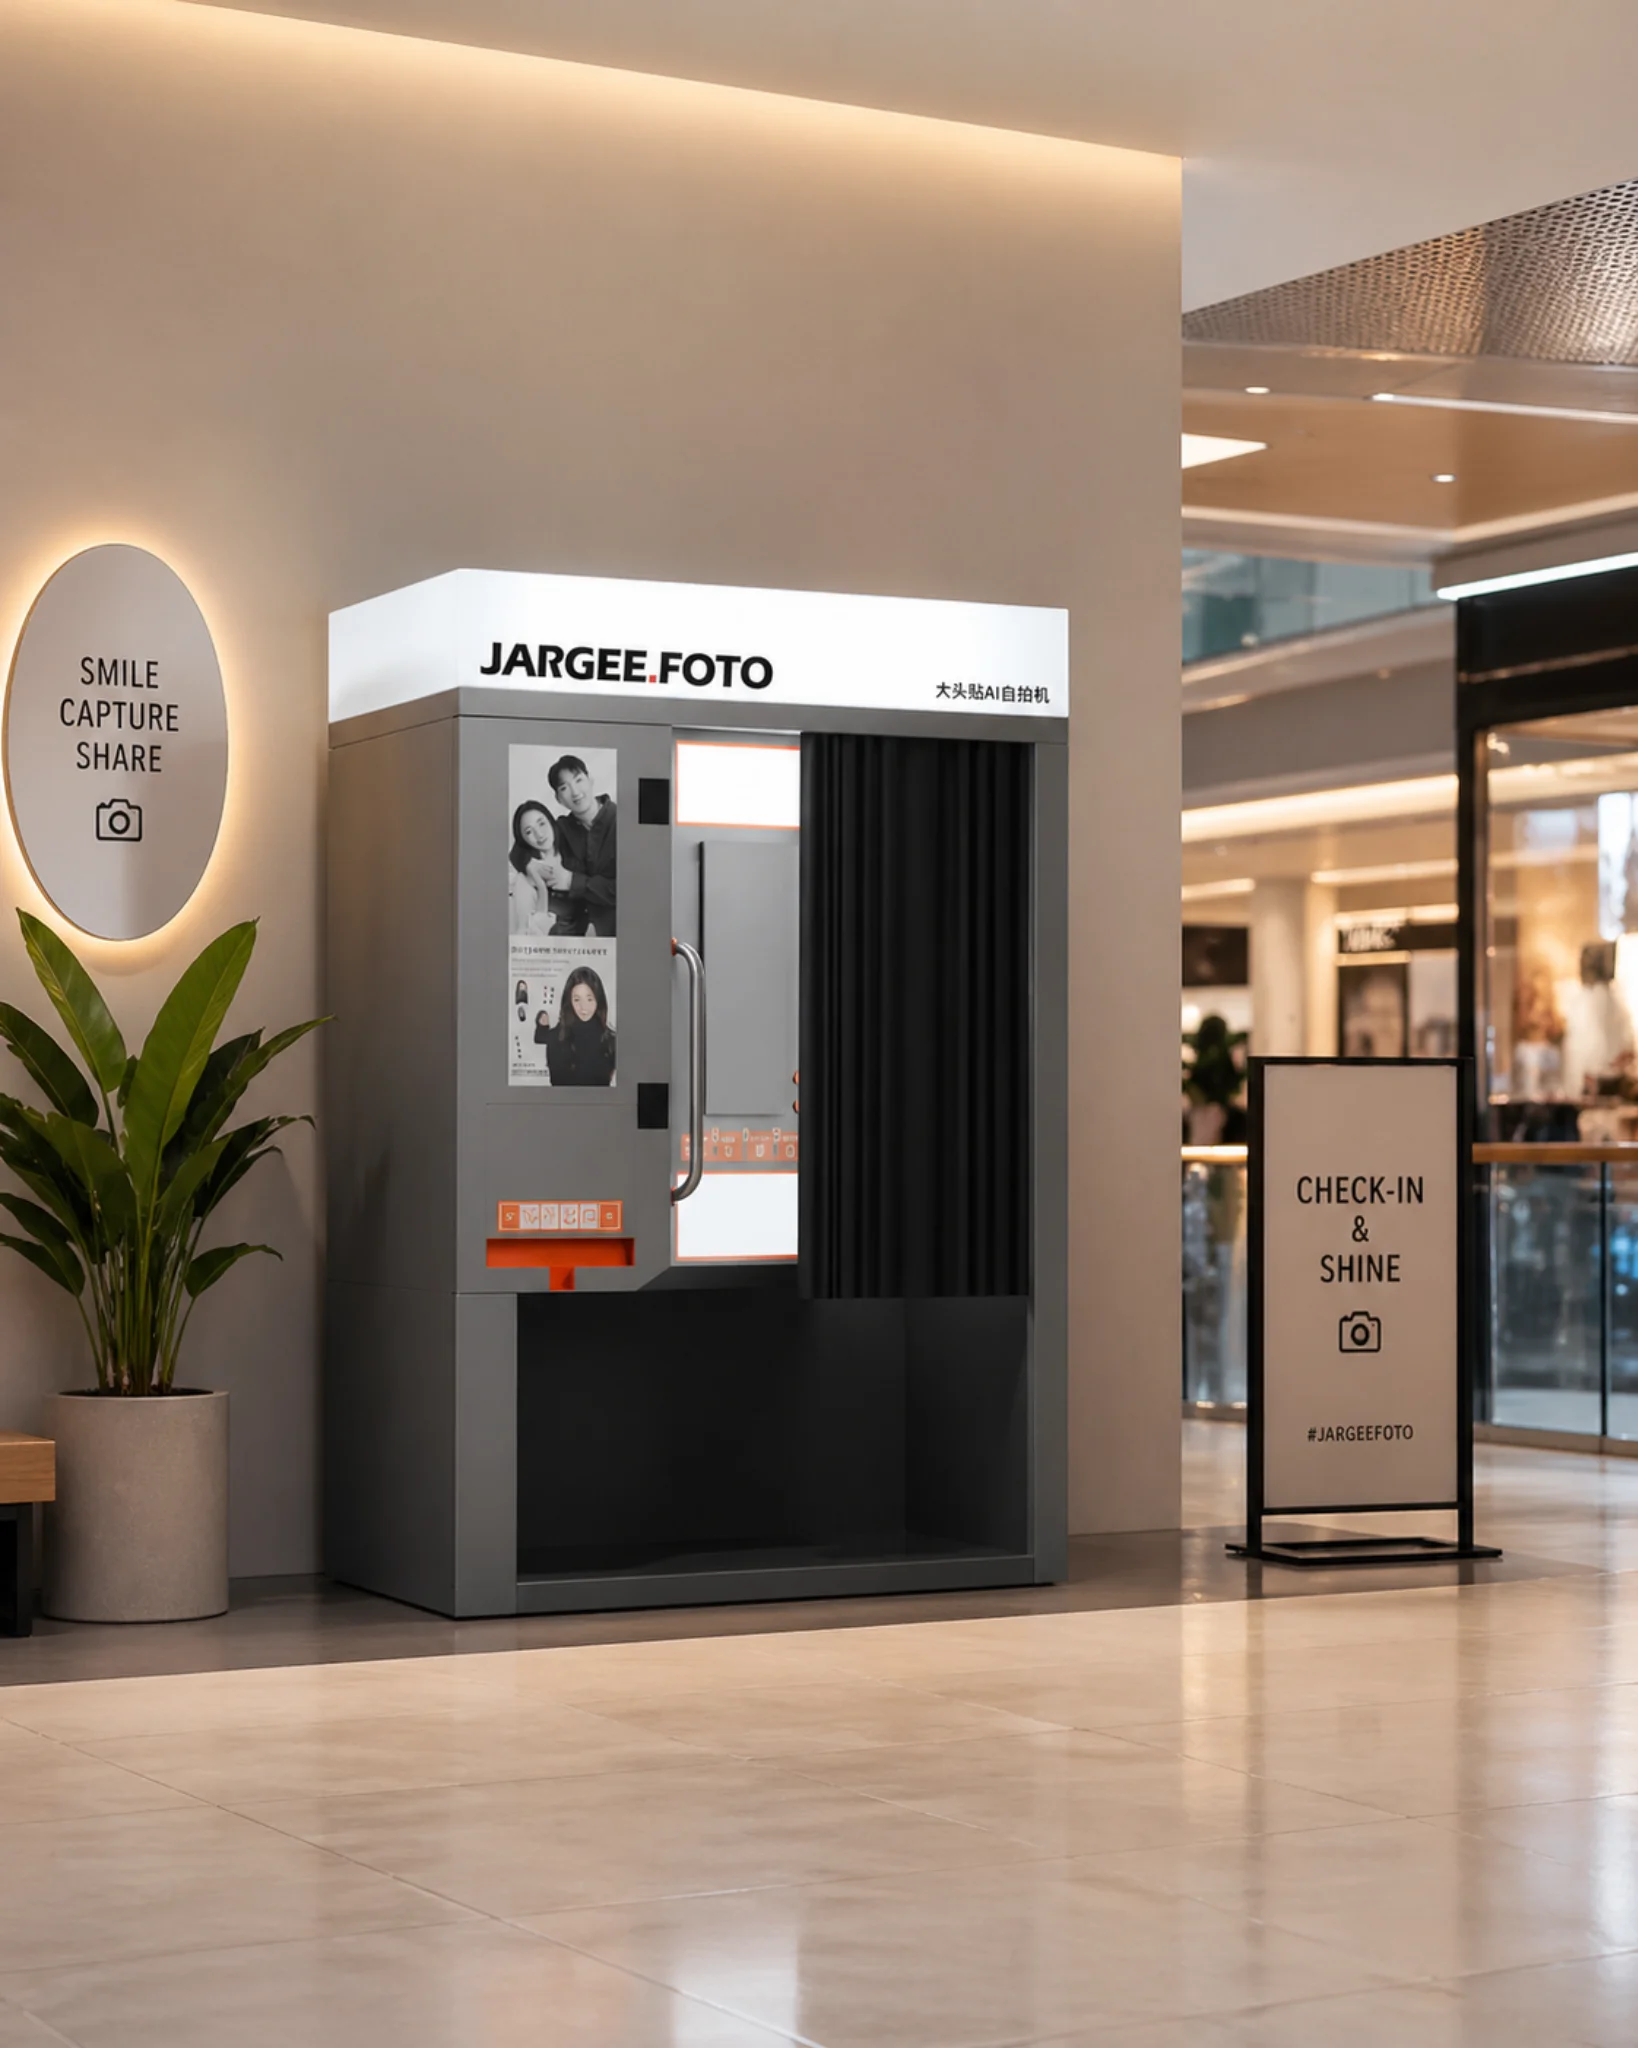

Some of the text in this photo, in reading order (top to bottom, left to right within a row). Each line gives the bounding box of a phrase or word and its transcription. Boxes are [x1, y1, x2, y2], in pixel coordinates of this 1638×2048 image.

[80, 656, 159, 689] SMILE
[480, 642, 773, 689] JARGEE.FOTO
[936, 682, 1050, 704] 大头贴AI自拍机
[60, 698, 179, 732] CAPTURE
[76, 741, 162, 772] SHARE
[1297, 1175, 1424, 1204] CHECK-IN
[1351, 1215, 1370, 1242] &
[1320, 1254, 1401, 1283] SHINE
[1307, 1425, 1414, 1442] #JARGEEFOTO
